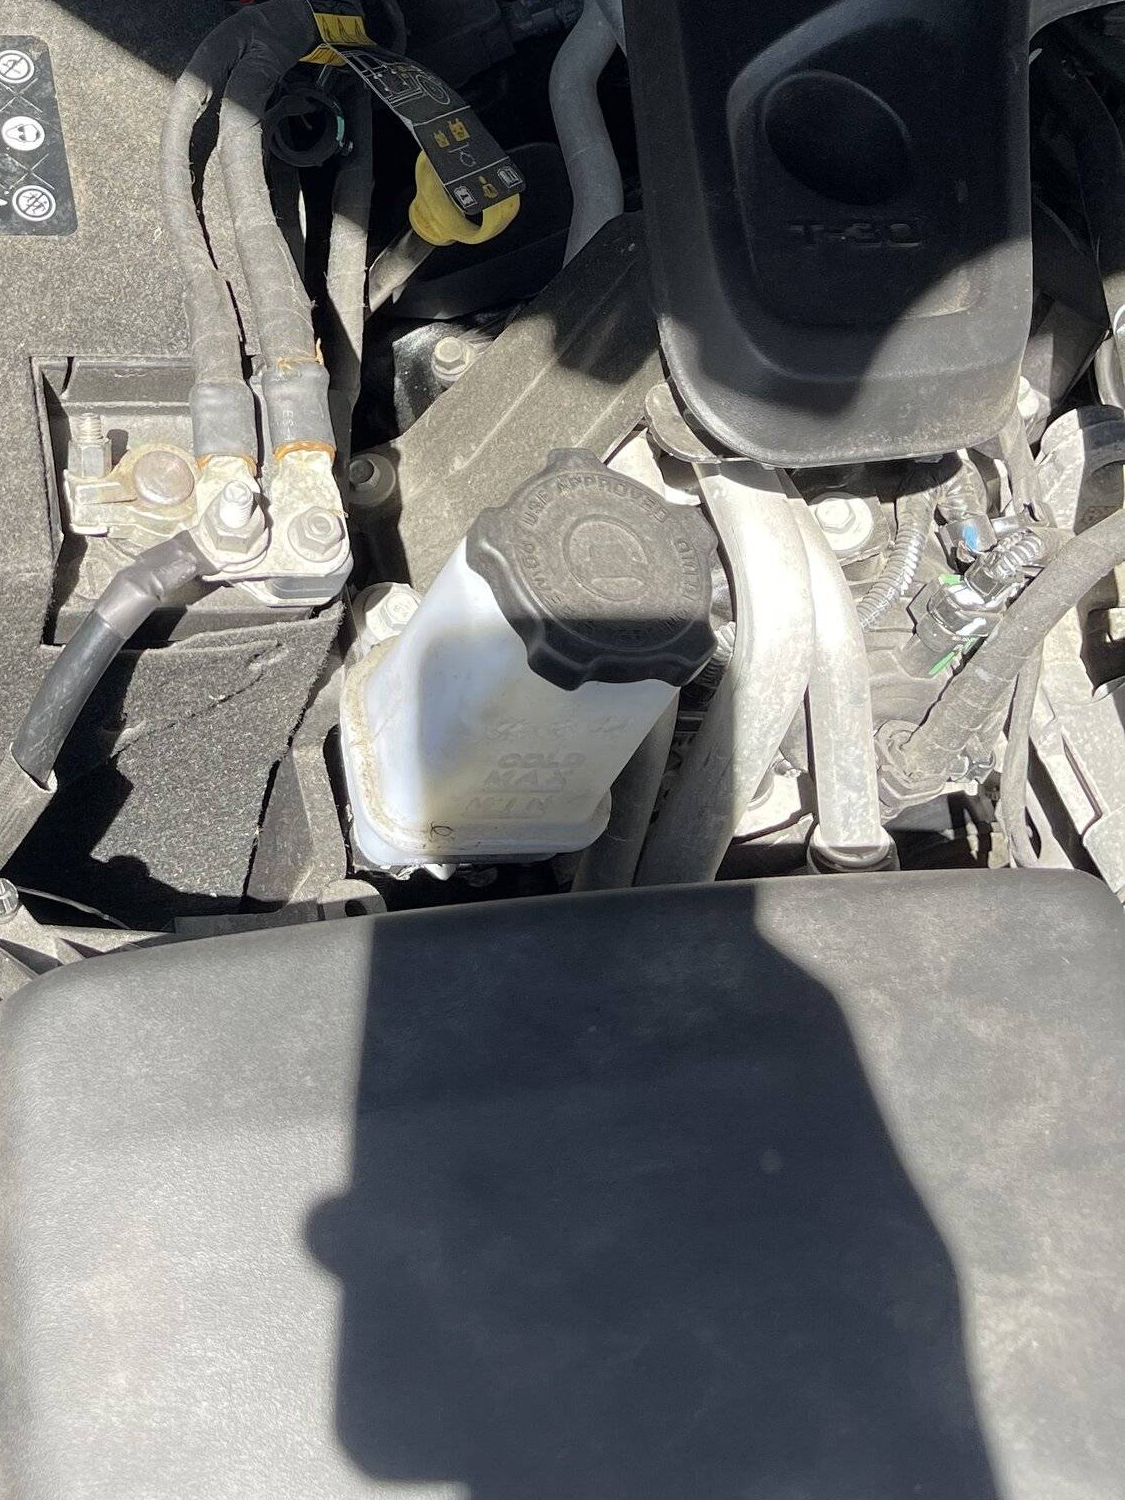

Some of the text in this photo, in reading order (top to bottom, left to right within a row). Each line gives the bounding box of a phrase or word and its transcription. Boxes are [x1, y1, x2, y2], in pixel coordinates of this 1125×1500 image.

[556, 473, 670, 524] APPROVED
[497, 752, 587, 768] COLD
[483, 768, 574, 790] MAX
[462, 795, 554, 816] MIN
